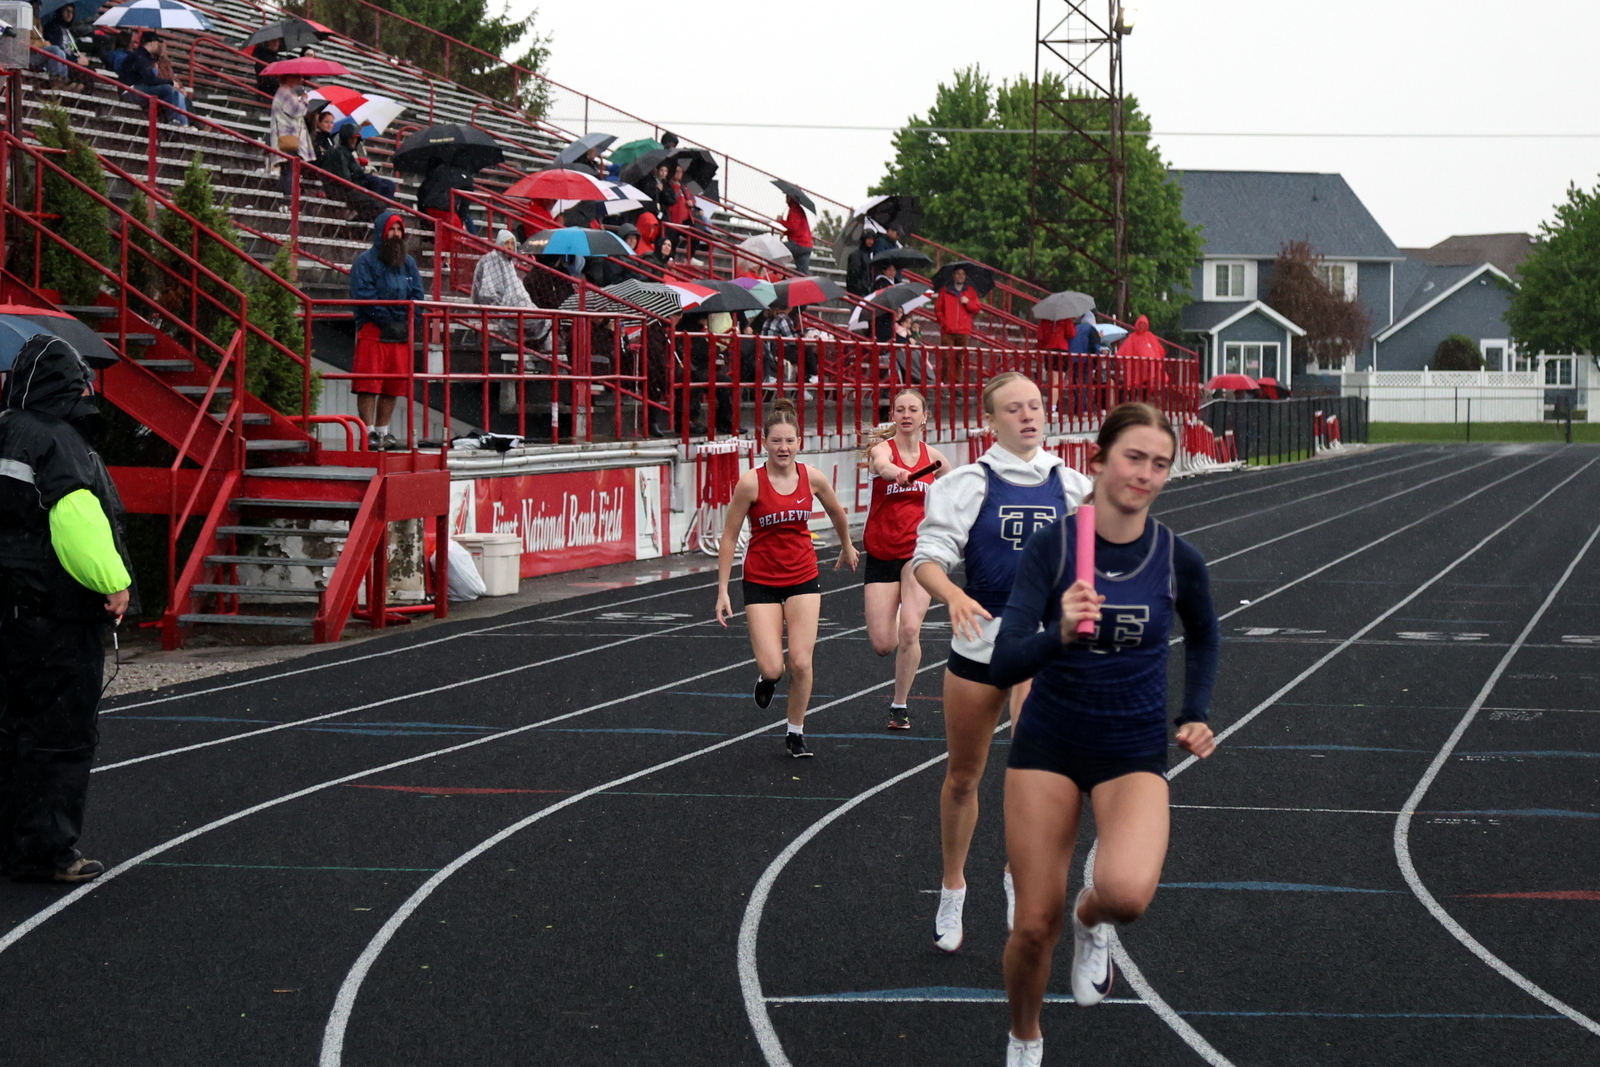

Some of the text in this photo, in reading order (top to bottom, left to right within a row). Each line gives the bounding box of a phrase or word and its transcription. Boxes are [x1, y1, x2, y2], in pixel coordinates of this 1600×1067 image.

[520, 491, 568, 554] National
[567, 489, 597, 547] Bank
[596, 486, 624, 543] Field
